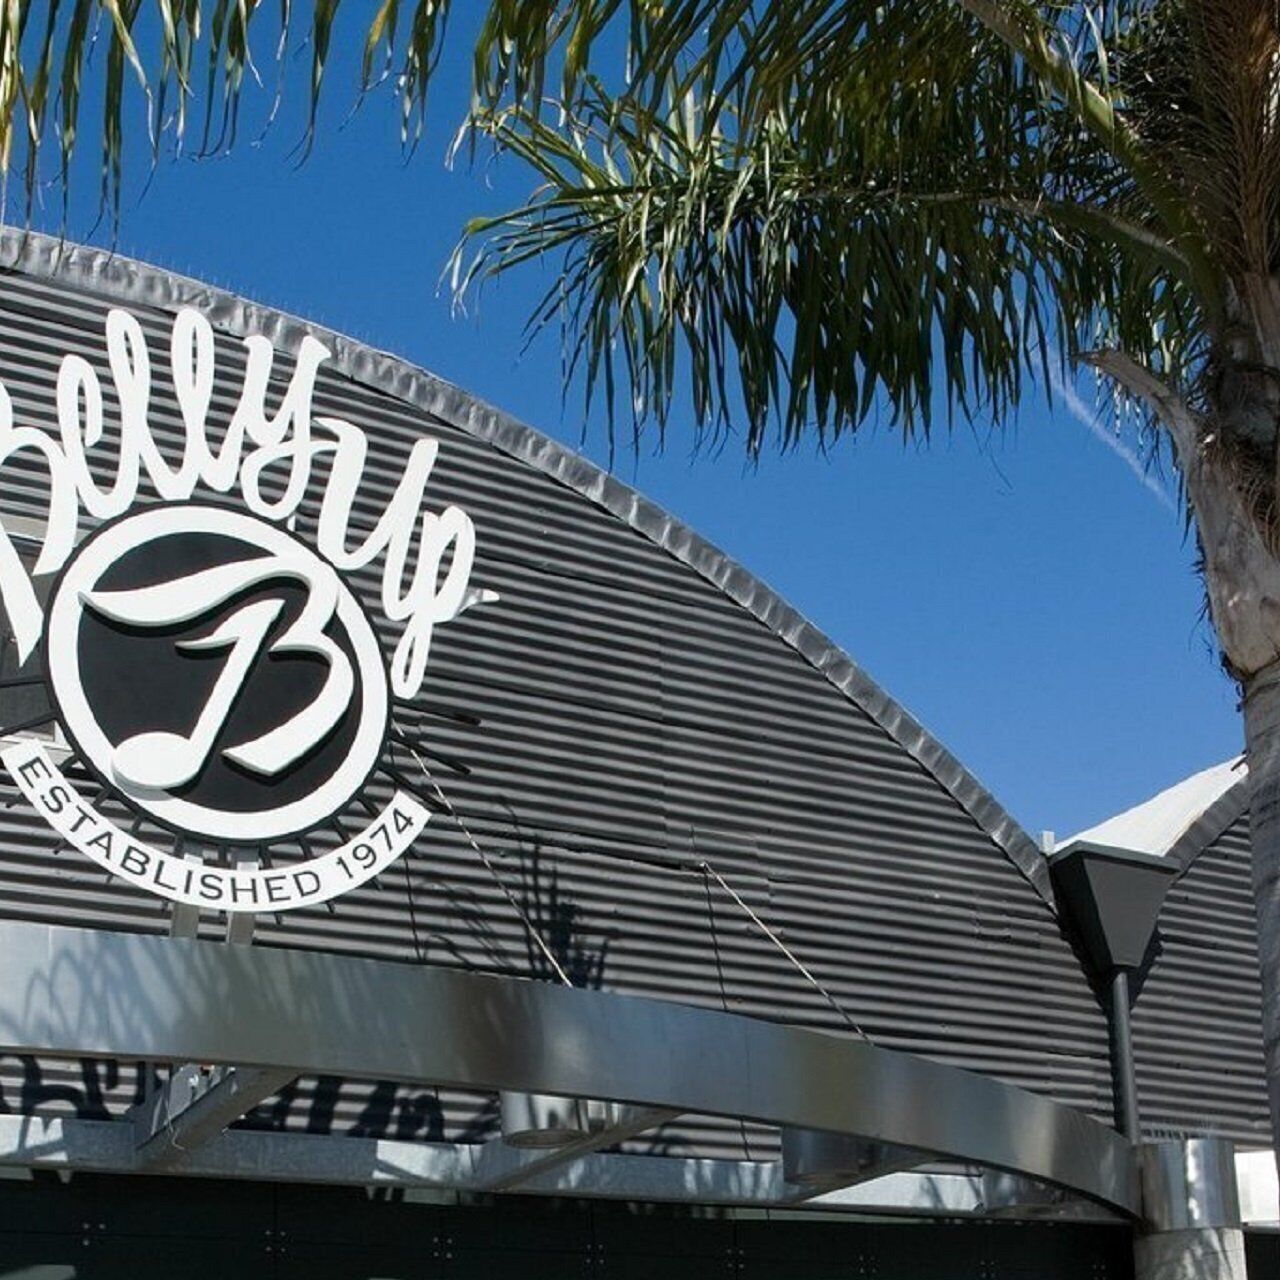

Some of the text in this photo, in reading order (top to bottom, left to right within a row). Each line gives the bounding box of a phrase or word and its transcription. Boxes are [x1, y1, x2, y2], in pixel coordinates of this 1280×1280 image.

[316, 416, 500, 700] Up
[17, 757, 414, 903] ESTABLISHED 1974
